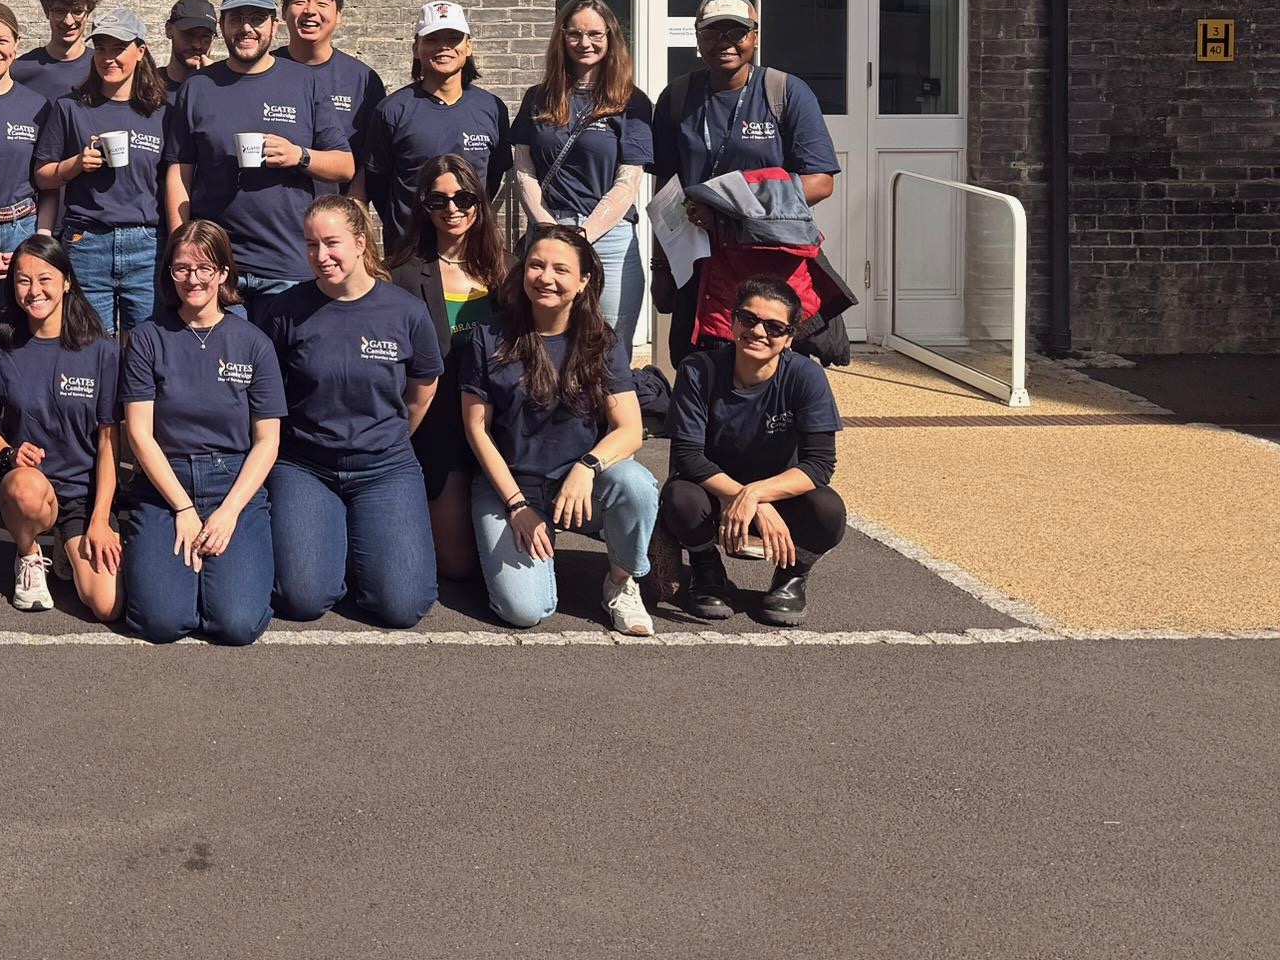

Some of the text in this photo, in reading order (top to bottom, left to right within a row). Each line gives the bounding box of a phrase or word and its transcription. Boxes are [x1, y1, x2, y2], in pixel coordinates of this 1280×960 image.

[1212, 26, 1220, 37] 3
[1209, 46, 1222, 55] 40
[270, 105, 297, 114] GATES
[13, 124, 35, 133] GATES
[137, 133, 160, 144] GATES
[451, 321, 479, 333] BRAS
[369, 340, 398, 351] GATES
[366, 347, 398, 357] Cambridge
[225, 362, 253, 373] GATES
[223, 370, 253, 380] Cambridge
[68, 376, 95, 387] GATES
[65, 384, 95, 394] Cambridge
